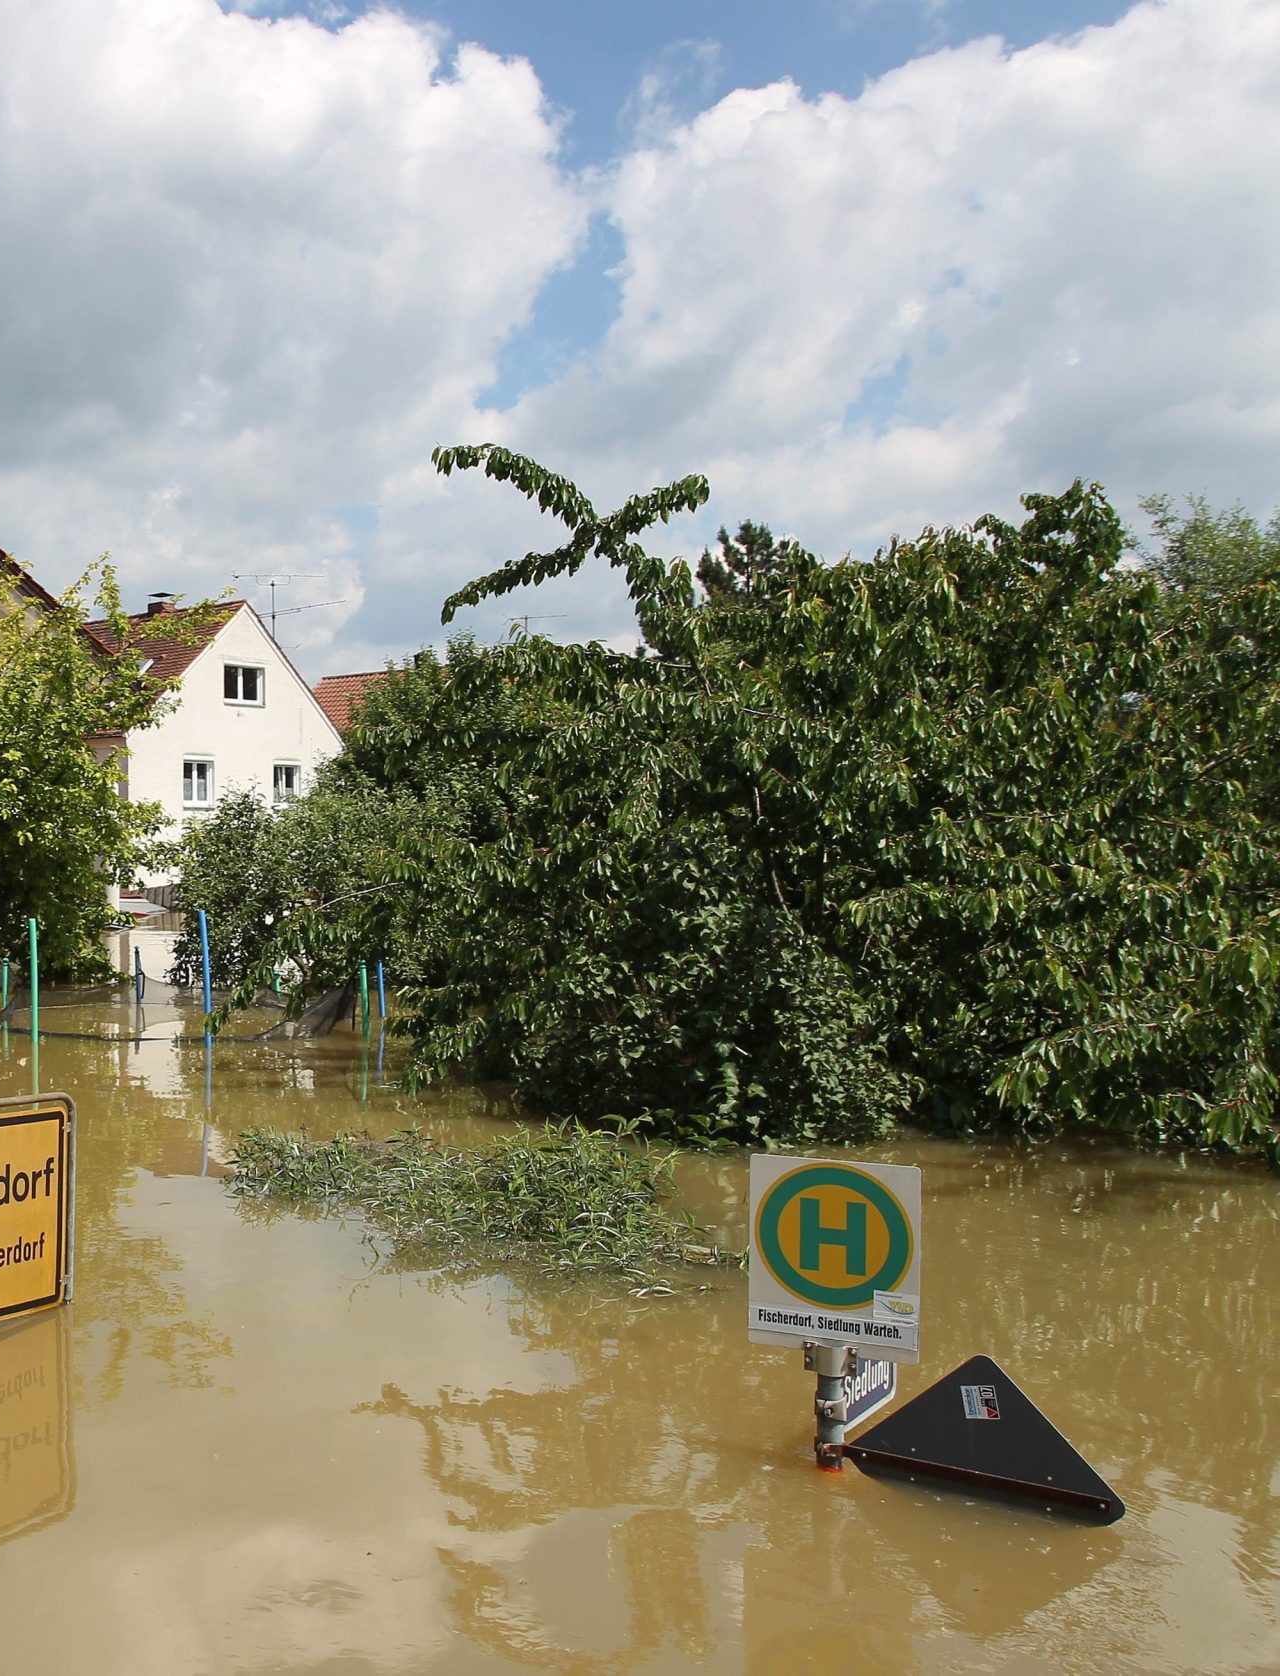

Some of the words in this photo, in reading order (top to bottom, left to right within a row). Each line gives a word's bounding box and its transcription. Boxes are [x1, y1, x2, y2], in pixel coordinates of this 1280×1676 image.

[799, 1197, 867, 1276] H
[758, 1309, 815, 1330] Fischerdorf,
[817, 1316, 861, 1335] Siedlung
[864, 1322, 902, 1340] Warteh.
[844, 1359, 890, 1408] Siedlung
[980, 1387, 993, 1397] 07
